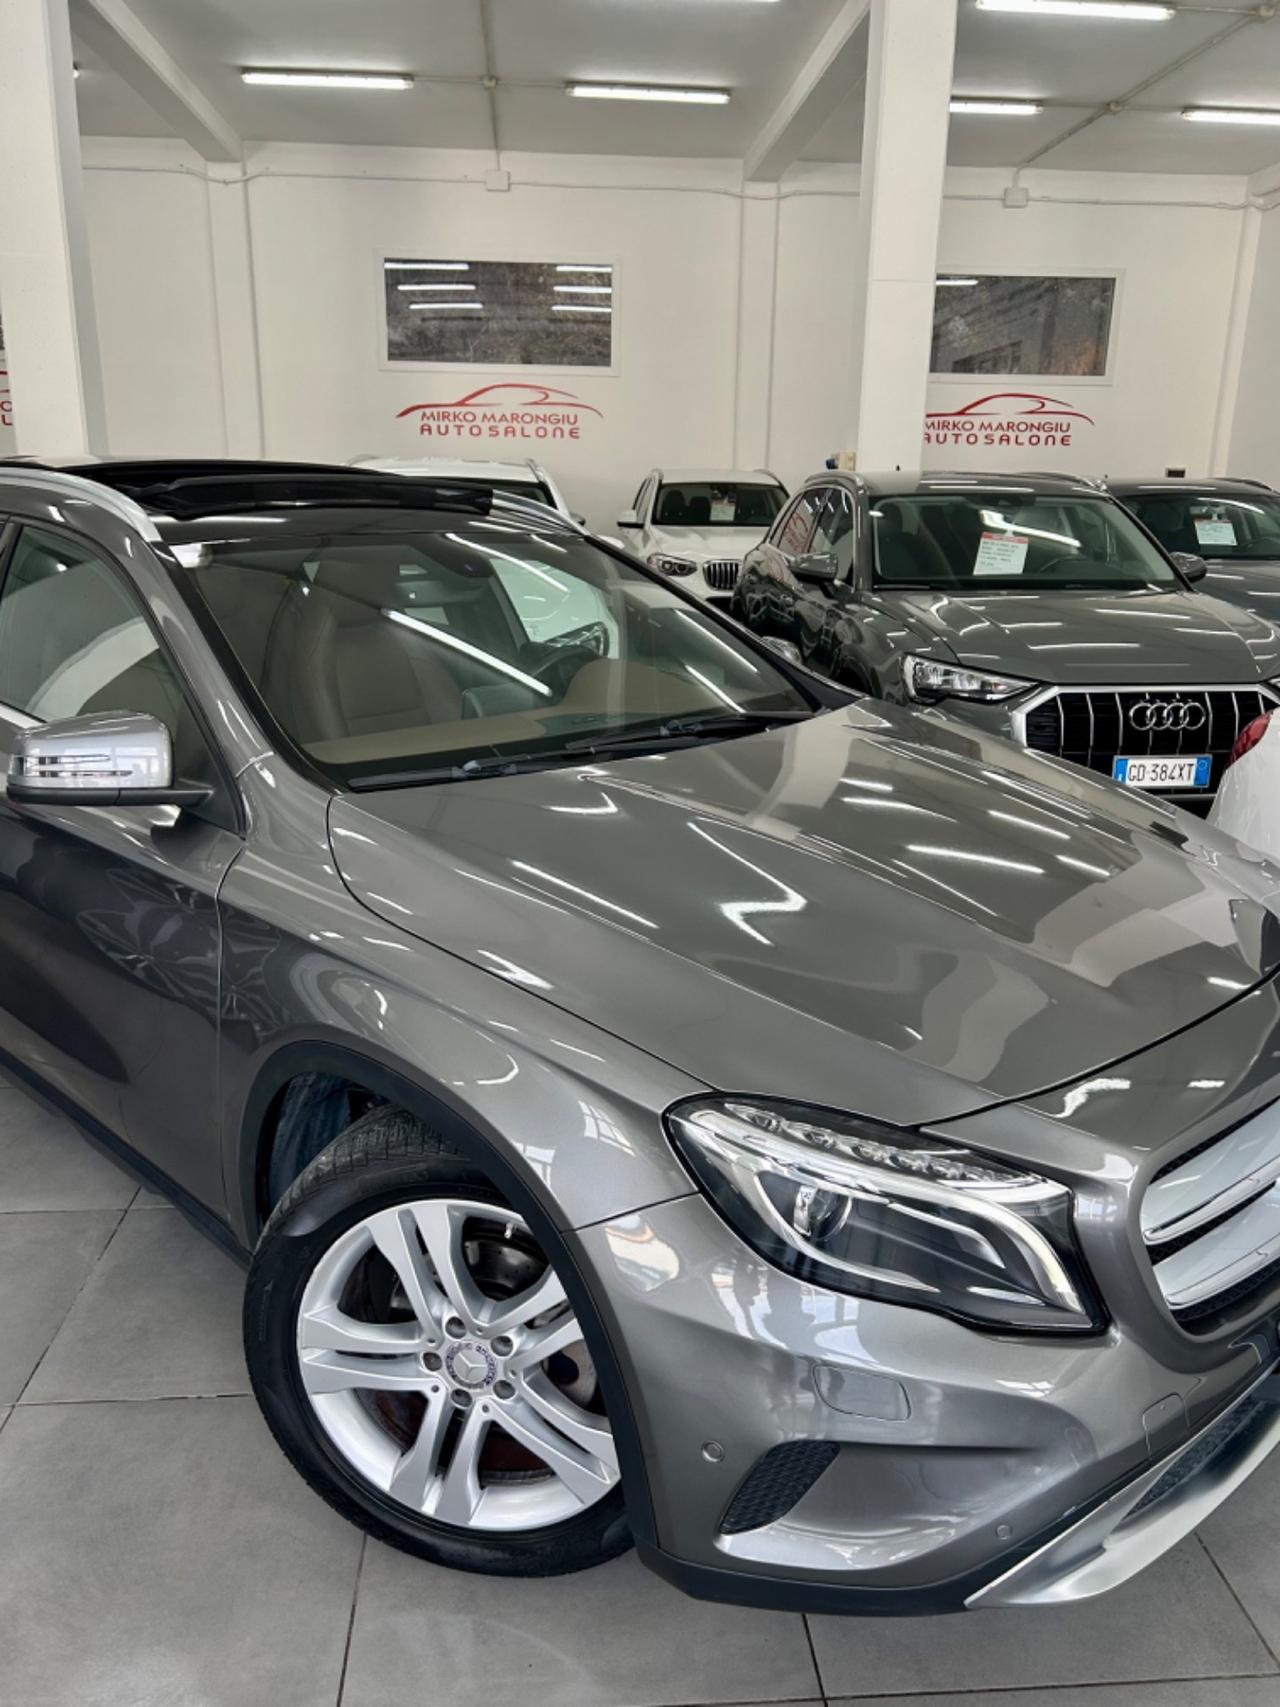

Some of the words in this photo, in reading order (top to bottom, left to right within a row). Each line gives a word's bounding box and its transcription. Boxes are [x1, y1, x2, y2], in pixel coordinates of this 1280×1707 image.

[421, 411, 476, 423] MIRKO
[481, 412, 578, 424] MARONGIU
[420, 423, 580, 439] AUTOSALONE
[978, 421, 1071, 433] MARONGIU
[1128, 764, 1146, 781] GD
[1149, 763, 1194, 781] 384XT
